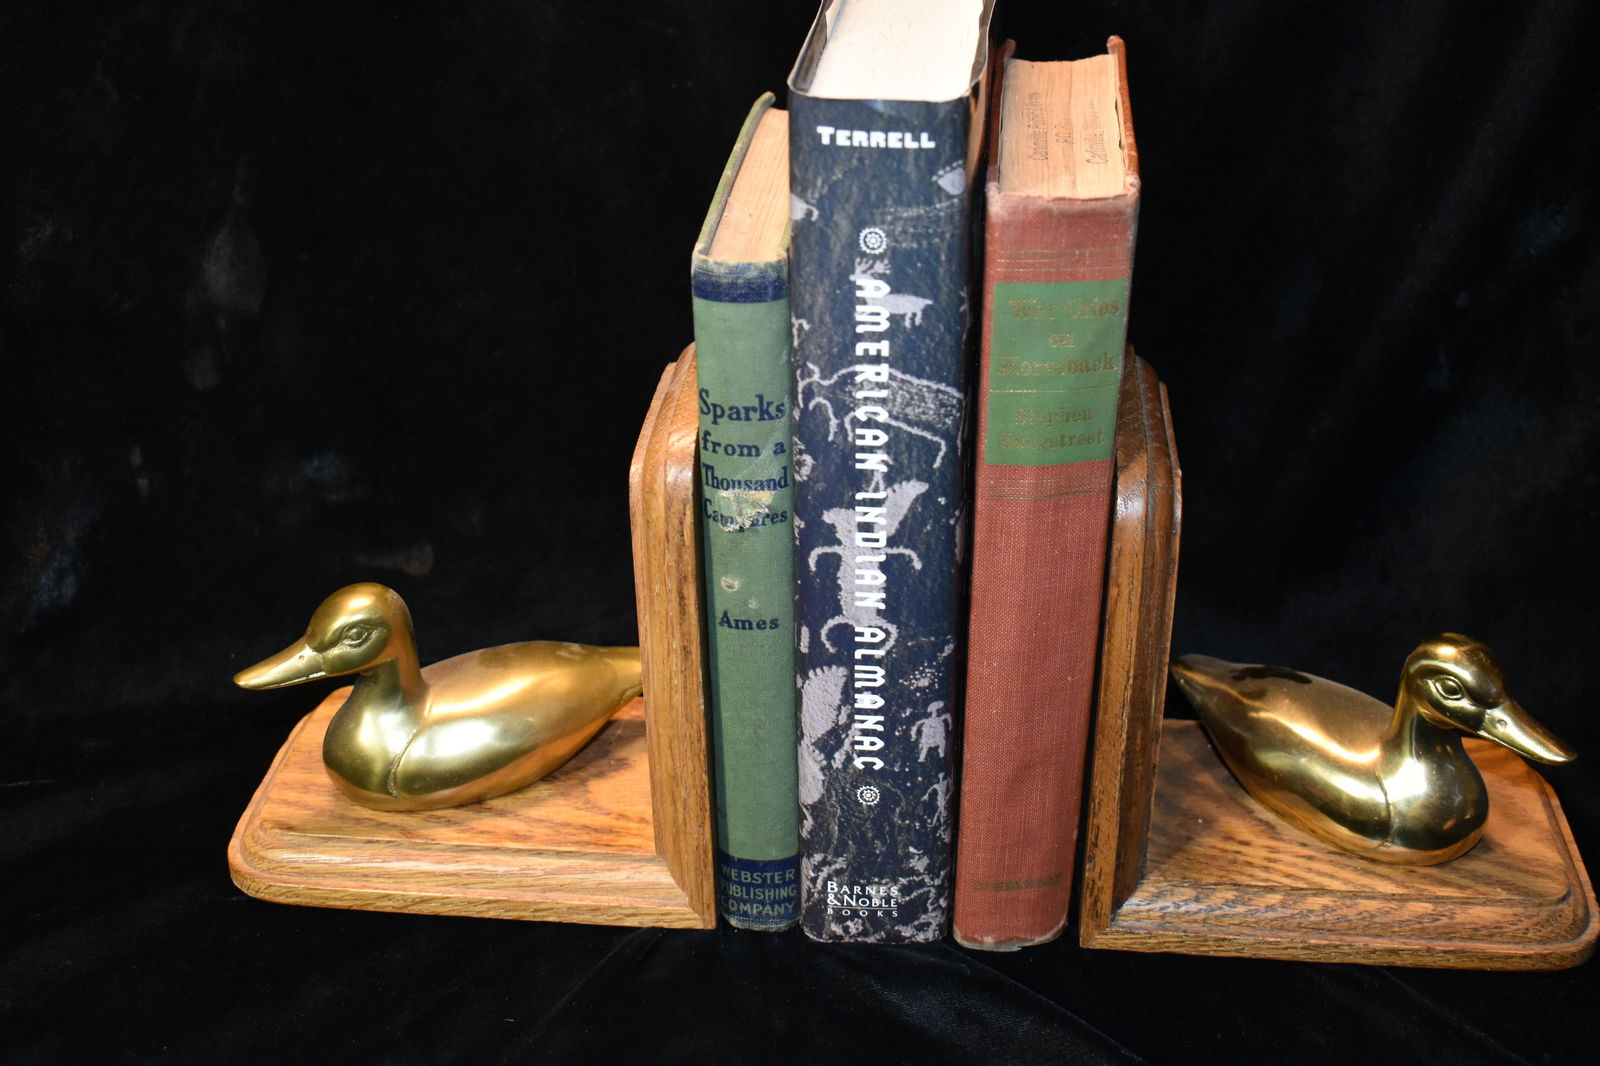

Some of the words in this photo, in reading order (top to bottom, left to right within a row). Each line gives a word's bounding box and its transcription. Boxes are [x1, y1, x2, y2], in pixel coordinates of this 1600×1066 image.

[816, 125, 936, 149] TERRELL
[855, 278, 891, 473] AMERICAN
[699, 388, 786, 425] Sparks
[701, 430, 761, 457] from
[773, 441, 786, 456] a
[702, 462, 790, 492] Thousand
[854, 491, 888, 610] INDIAN
[718, 610, 780, 630] Ames
[853, 626, 886, 771] ALMANAC
[721, 863, 796, 884] WEBSTER
[827, 881, 898, 896] BARNES
[828, 908, 898, 917] BOOKS
